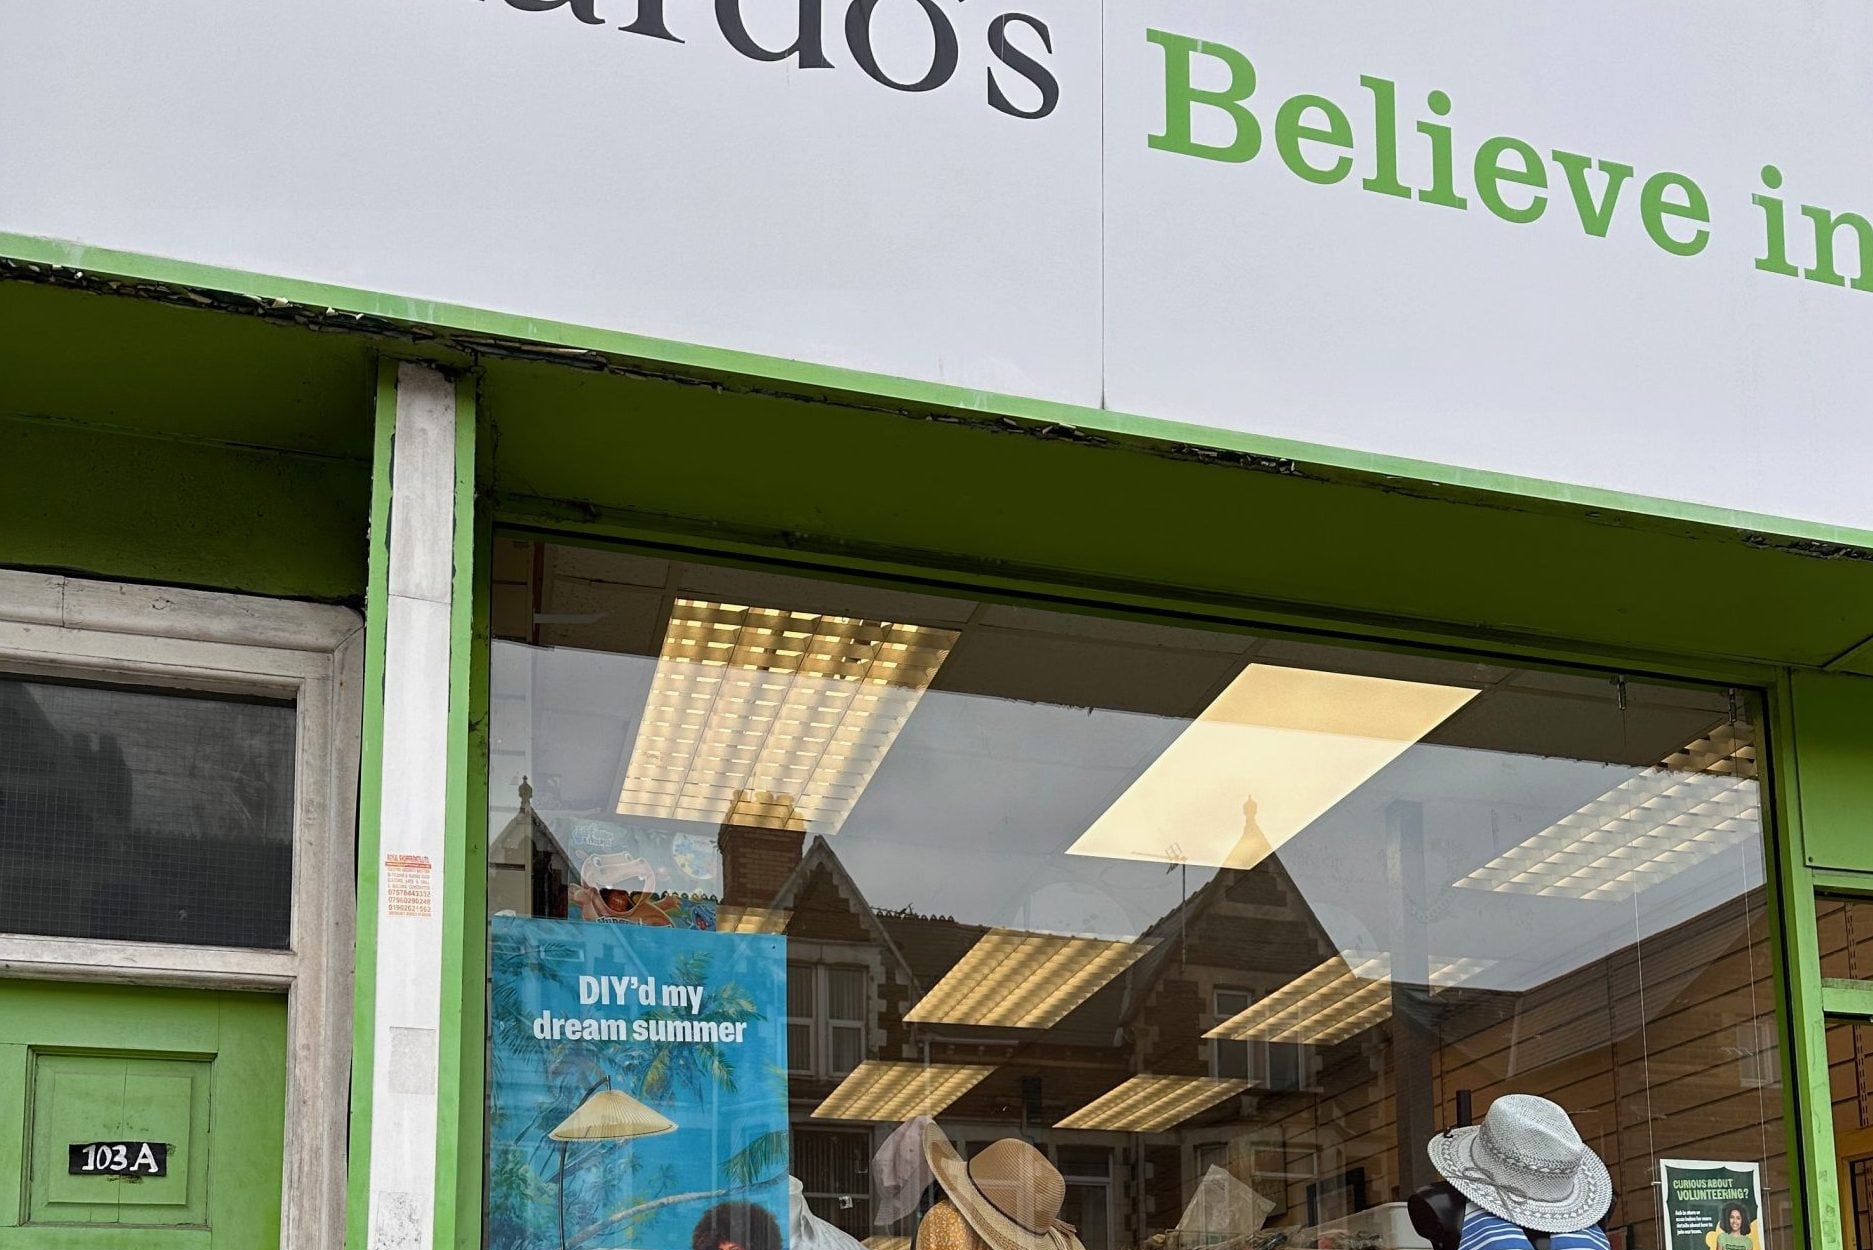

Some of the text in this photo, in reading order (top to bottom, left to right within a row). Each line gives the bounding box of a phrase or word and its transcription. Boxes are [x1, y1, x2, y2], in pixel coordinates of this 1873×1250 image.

[1145, 27, 1711, 257] Believe
[579, 975, 704, 1015] DIY'd my
[533, 1011, 748, 1043] dream summer
[1673, 1179, 1734, 1189] CURIOUS ABOUT
[1677, 1188, 1749, 1201] VOLUNTEERING?
